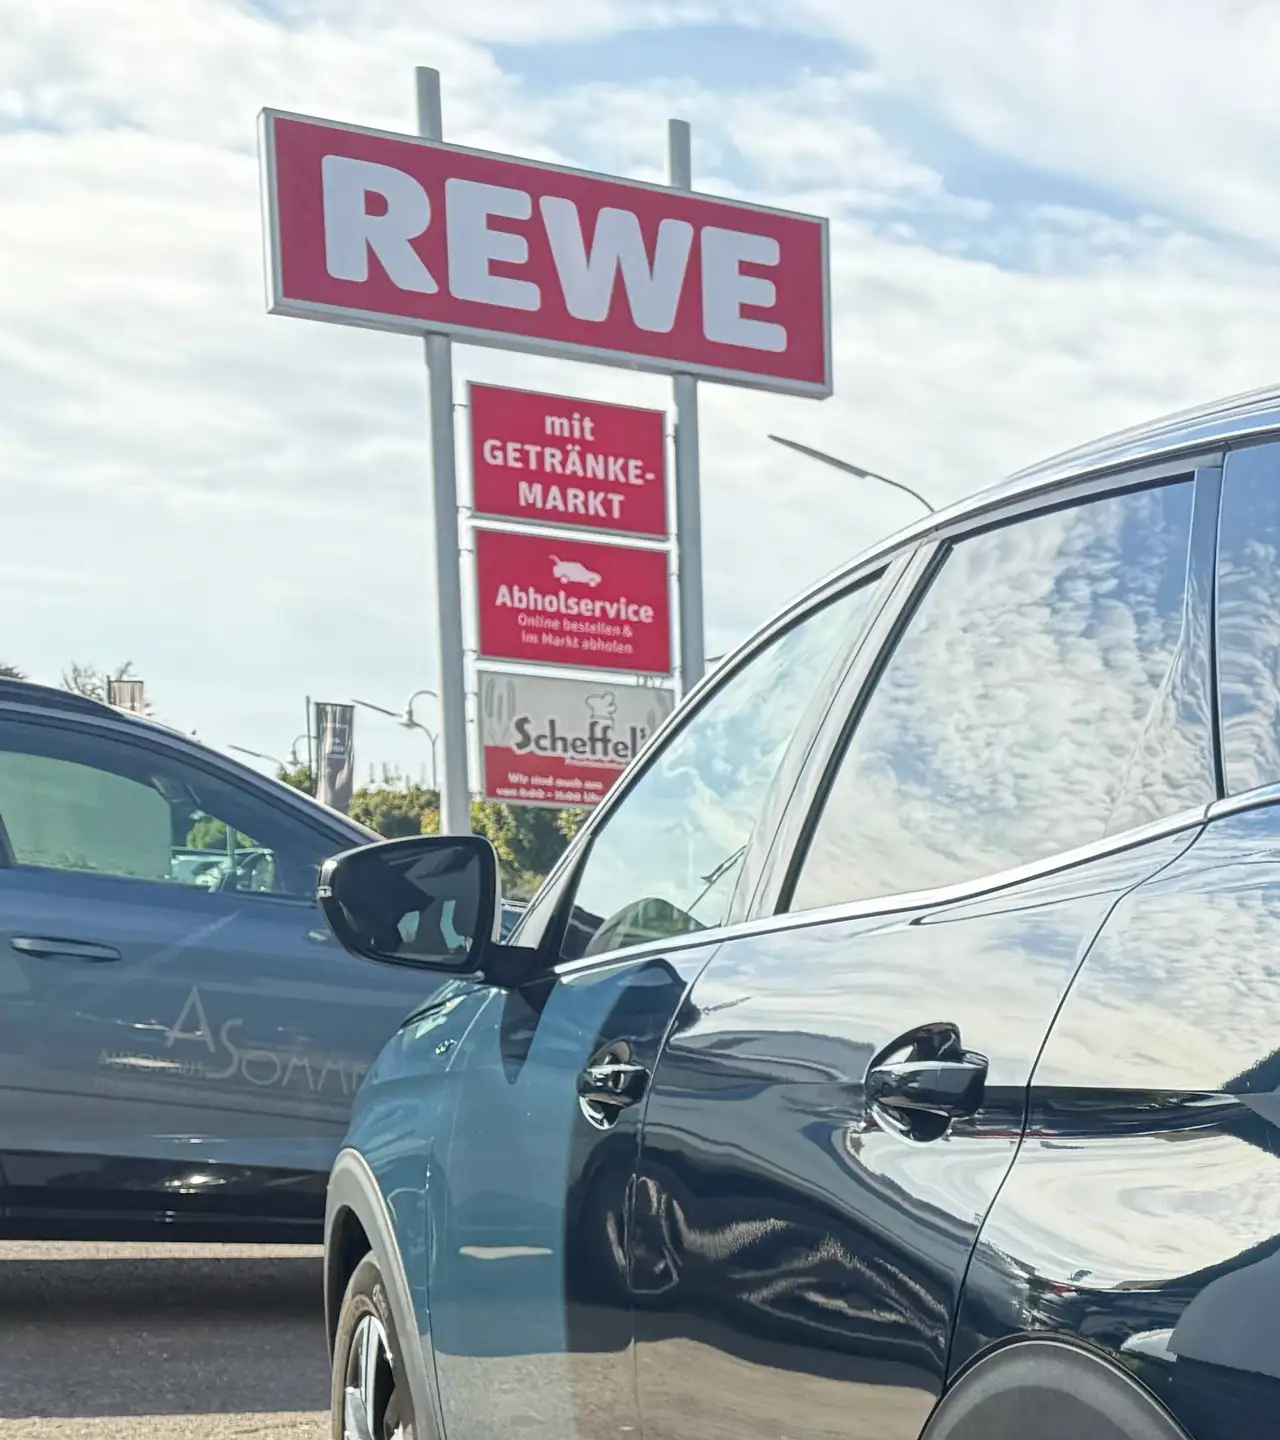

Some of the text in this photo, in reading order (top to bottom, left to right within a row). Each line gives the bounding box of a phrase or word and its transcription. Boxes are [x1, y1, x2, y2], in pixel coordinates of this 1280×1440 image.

[320, 154, 788, 353] REWE
[544, 412, 595, 441] mit
[482, 439, 656, 485] GETRÄNKE-
[518, 480, 625, 519] MARKT
[494, 584, 654, 623] Abholservice
[517, 613, 633, 638] Online bestellen &
[541, 633, 579, 650] Markt
[582, 639, 634, 654] abholen
